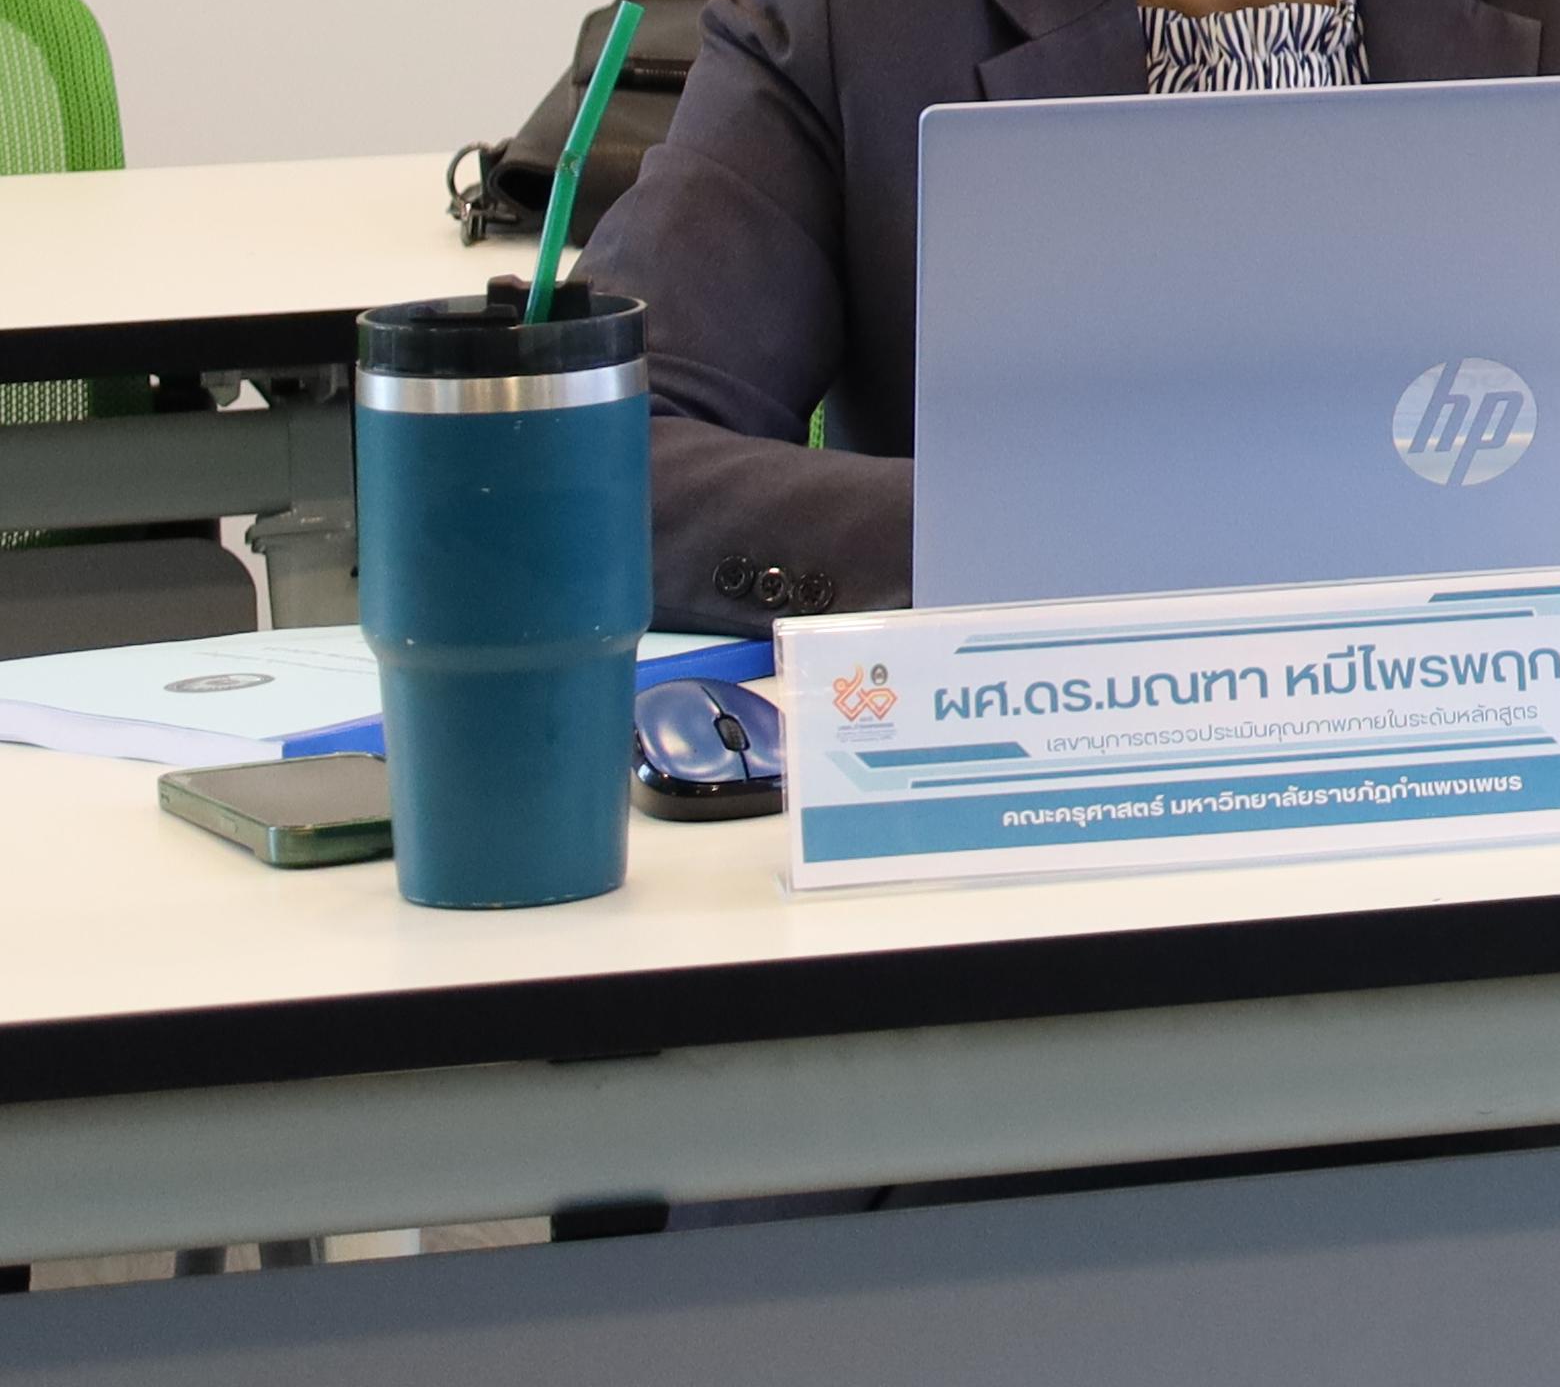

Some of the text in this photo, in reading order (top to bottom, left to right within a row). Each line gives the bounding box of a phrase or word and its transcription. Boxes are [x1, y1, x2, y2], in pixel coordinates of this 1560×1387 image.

[1405, 357, 1526, 487] hp
[932, 660, 1269, 723] ผศ.ดร.มณฑา
[1045, 702, 1539, 755] เลขานุการตรวจประเมินคุณภาพภายในระดับหลักสูตร
[1001, 770, 1523, 829] คณะครุศาสตร์ มหาวิทยาลัยราชภัฏกำแพงเพชร
